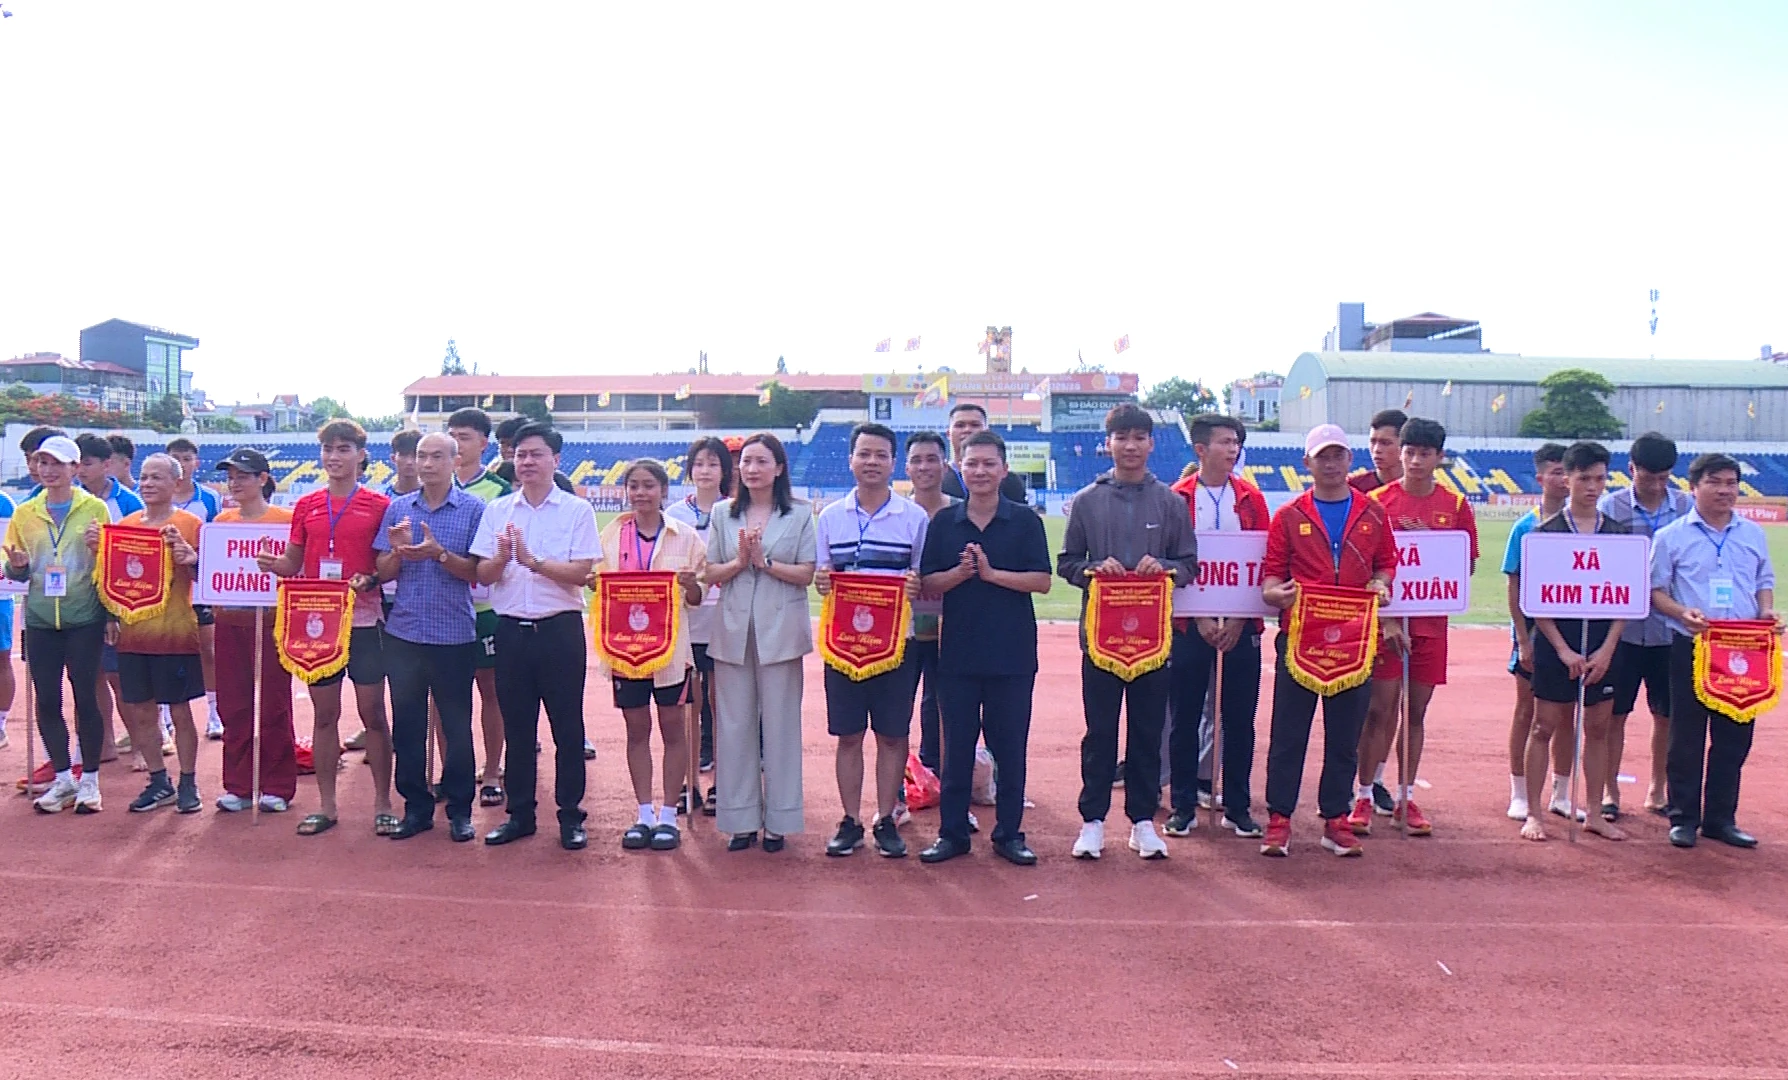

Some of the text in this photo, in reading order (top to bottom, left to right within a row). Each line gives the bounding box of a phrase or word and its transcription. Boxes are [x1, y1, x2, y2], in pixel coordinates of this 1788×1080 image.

[1572, 548, 1600, 570] XÃ
[212, 566, 271, 593] QUẢNG
[1401, 576, 1458, 601] XUÂN
[1541, 581, 1630, 605] KIM TÂN
